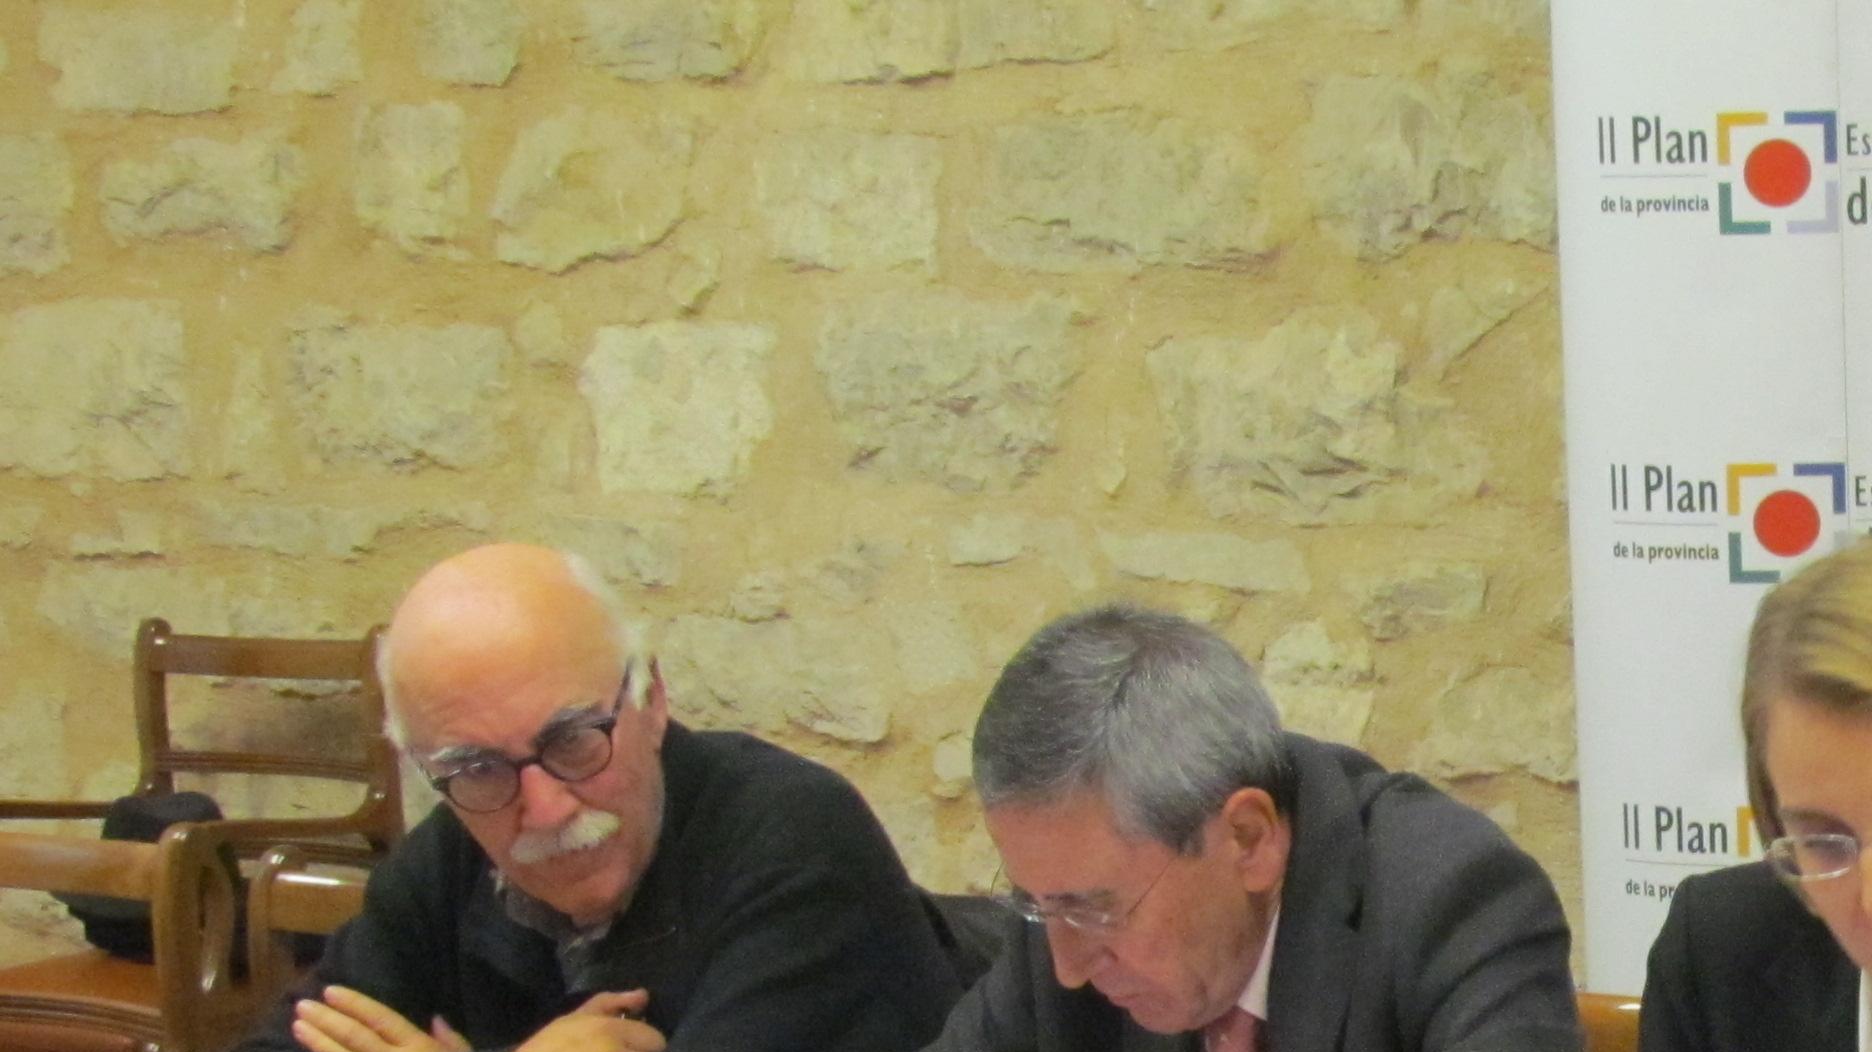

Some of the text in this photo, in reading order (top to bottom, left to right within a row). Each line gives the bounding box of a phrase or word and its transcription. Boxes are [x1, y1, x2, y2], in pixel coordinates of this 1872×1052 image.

[1598, 115, 1708, 164] II Plan
[1600, 194, 1710, 218] de la provincia
[1610, 463, 1718, 513] II Plan
[1613, 541, 1720, 564] de la provincia
[1623, 803, 1728, 854] II Plan
[1625, 879, 1641, 895] de
[1643, 881, 1656, 897] la
